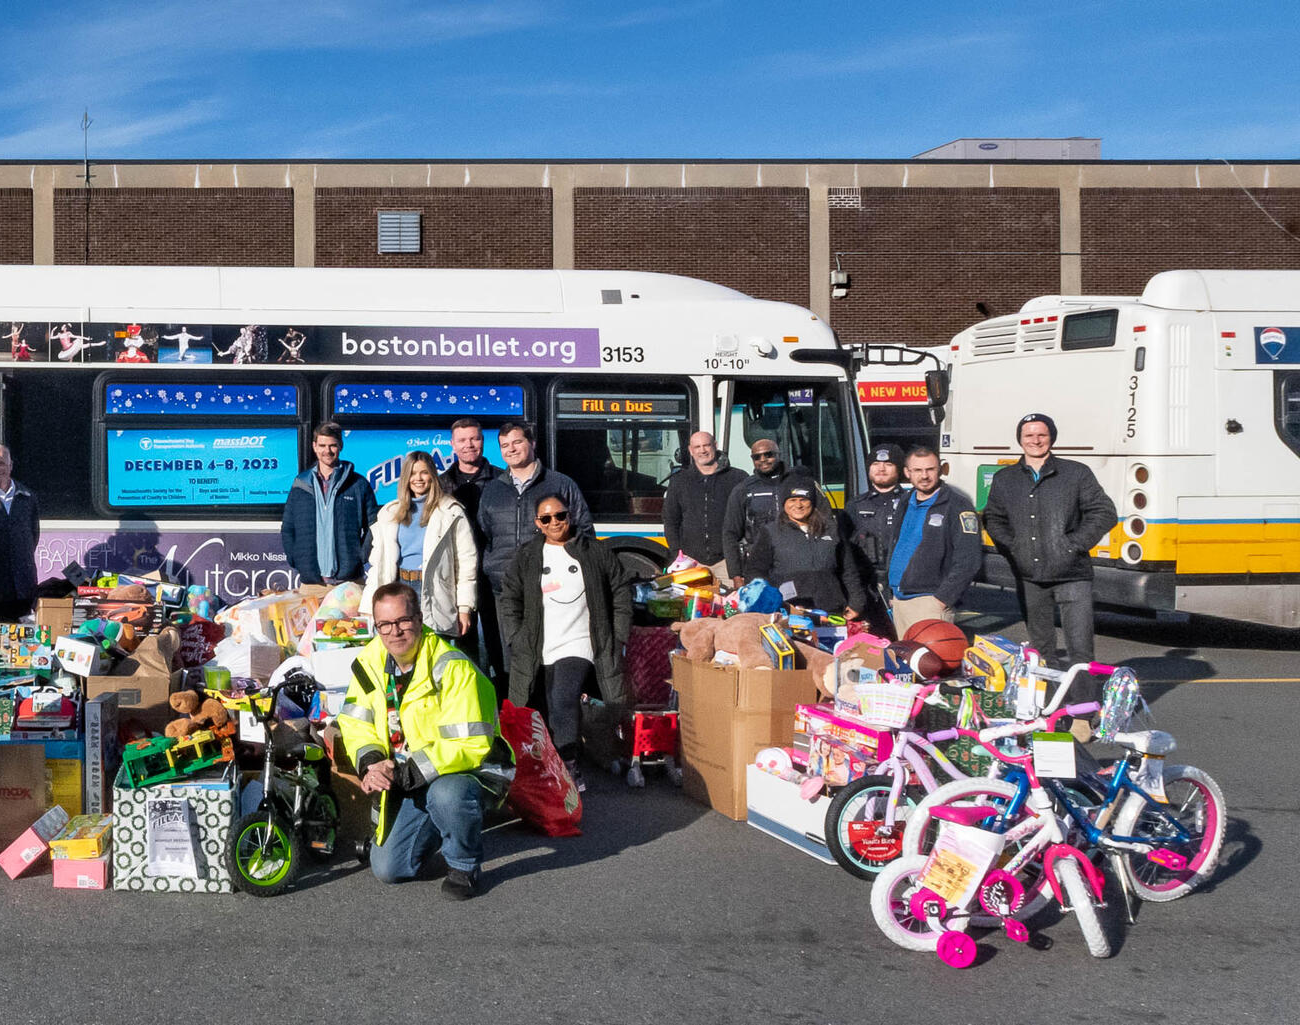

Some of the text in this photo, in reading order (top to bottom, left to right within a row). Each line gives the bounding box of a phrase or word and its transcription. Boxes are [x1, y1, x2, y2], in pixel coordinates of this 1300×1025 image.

[341, 332, 577, 364] bostonballet.org
[602, 347, 645, 363] 3153
[871, 386, 896, 398] NEW
[582, 399, 653, 413] Fill a bus
[213, 436, 267, 446] massDOT
[124, 459, 203, 472] DECEMBER
[242, 458, 278, 471] 2023
[230, 551, 259, 562] Mikko
